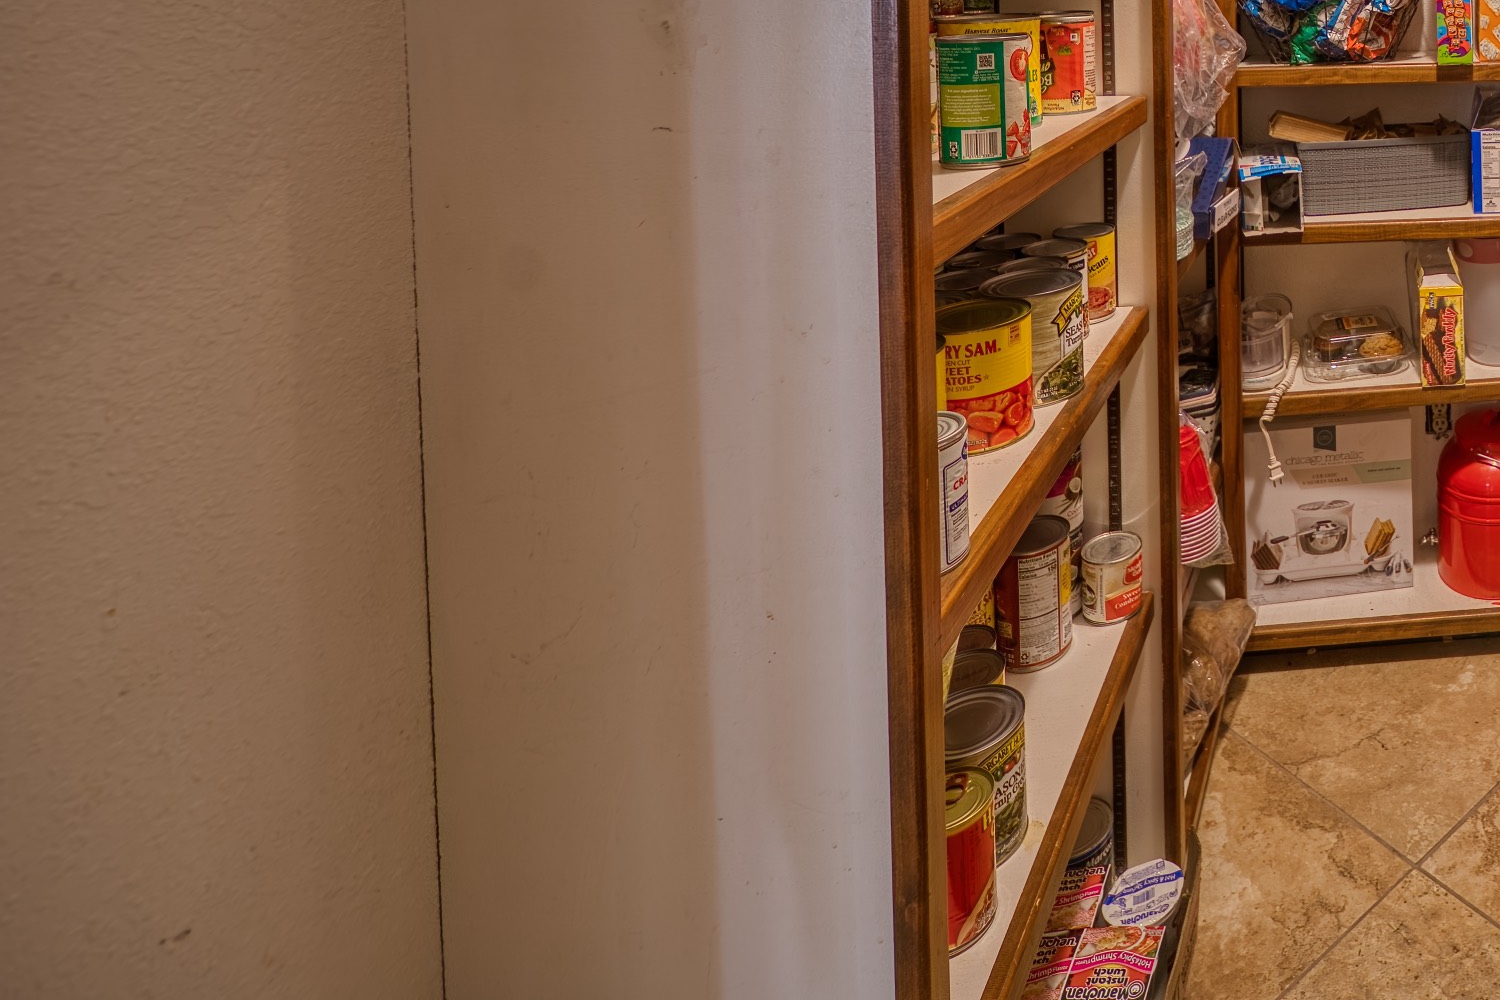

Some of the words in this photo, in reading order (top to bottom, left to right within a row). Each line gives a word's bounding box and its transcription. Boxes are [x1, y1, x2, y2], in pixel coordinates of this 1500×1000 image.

[955, 385, 975, 393] SYRUP
[1285, 454, 1322, 466] chicago
[1325, 451, 1364, 462] metallic
[1086, 976, 1128, 986] Instant
